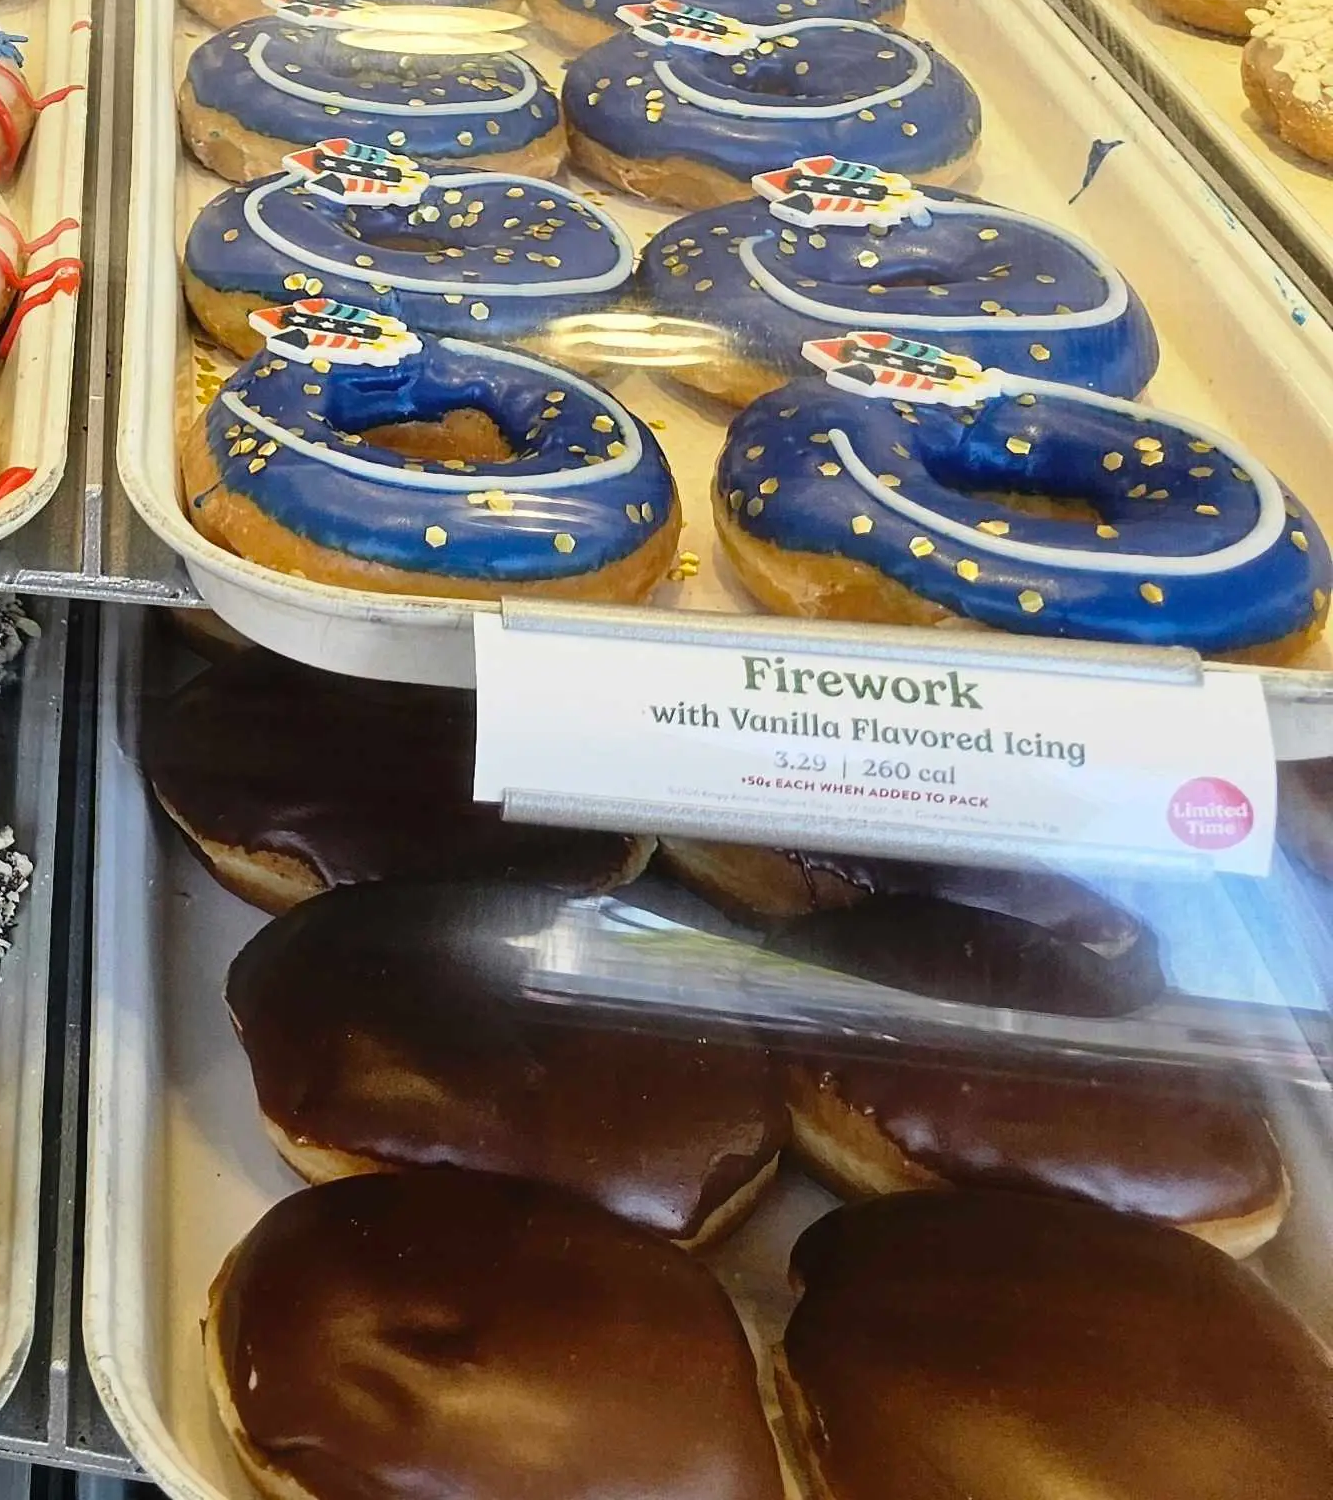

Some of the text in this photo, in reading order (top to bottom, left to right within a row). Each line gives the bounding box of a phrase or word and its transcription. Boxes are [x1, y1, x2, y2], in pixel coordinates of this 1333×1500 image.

[743, 655, 983, 710] Firework
[650, 702, 1086, 768] with Vanilla Flavored Icing
[774, 751, 827, 772] 3.29
[863, 759, 910, 780] 260
[919, 766, 956, 785] cal
[775, 778, 815, 791] EACH
[820, 782, 864, 796] WHEN
[868, 789, 921, 801] ADDED
[926, 792, 945, 804] TO
[949, 795, 989, 808] PACK
[1173, 802, 1248, 818] Limited
[1187, 821, 1237, 835] Time
